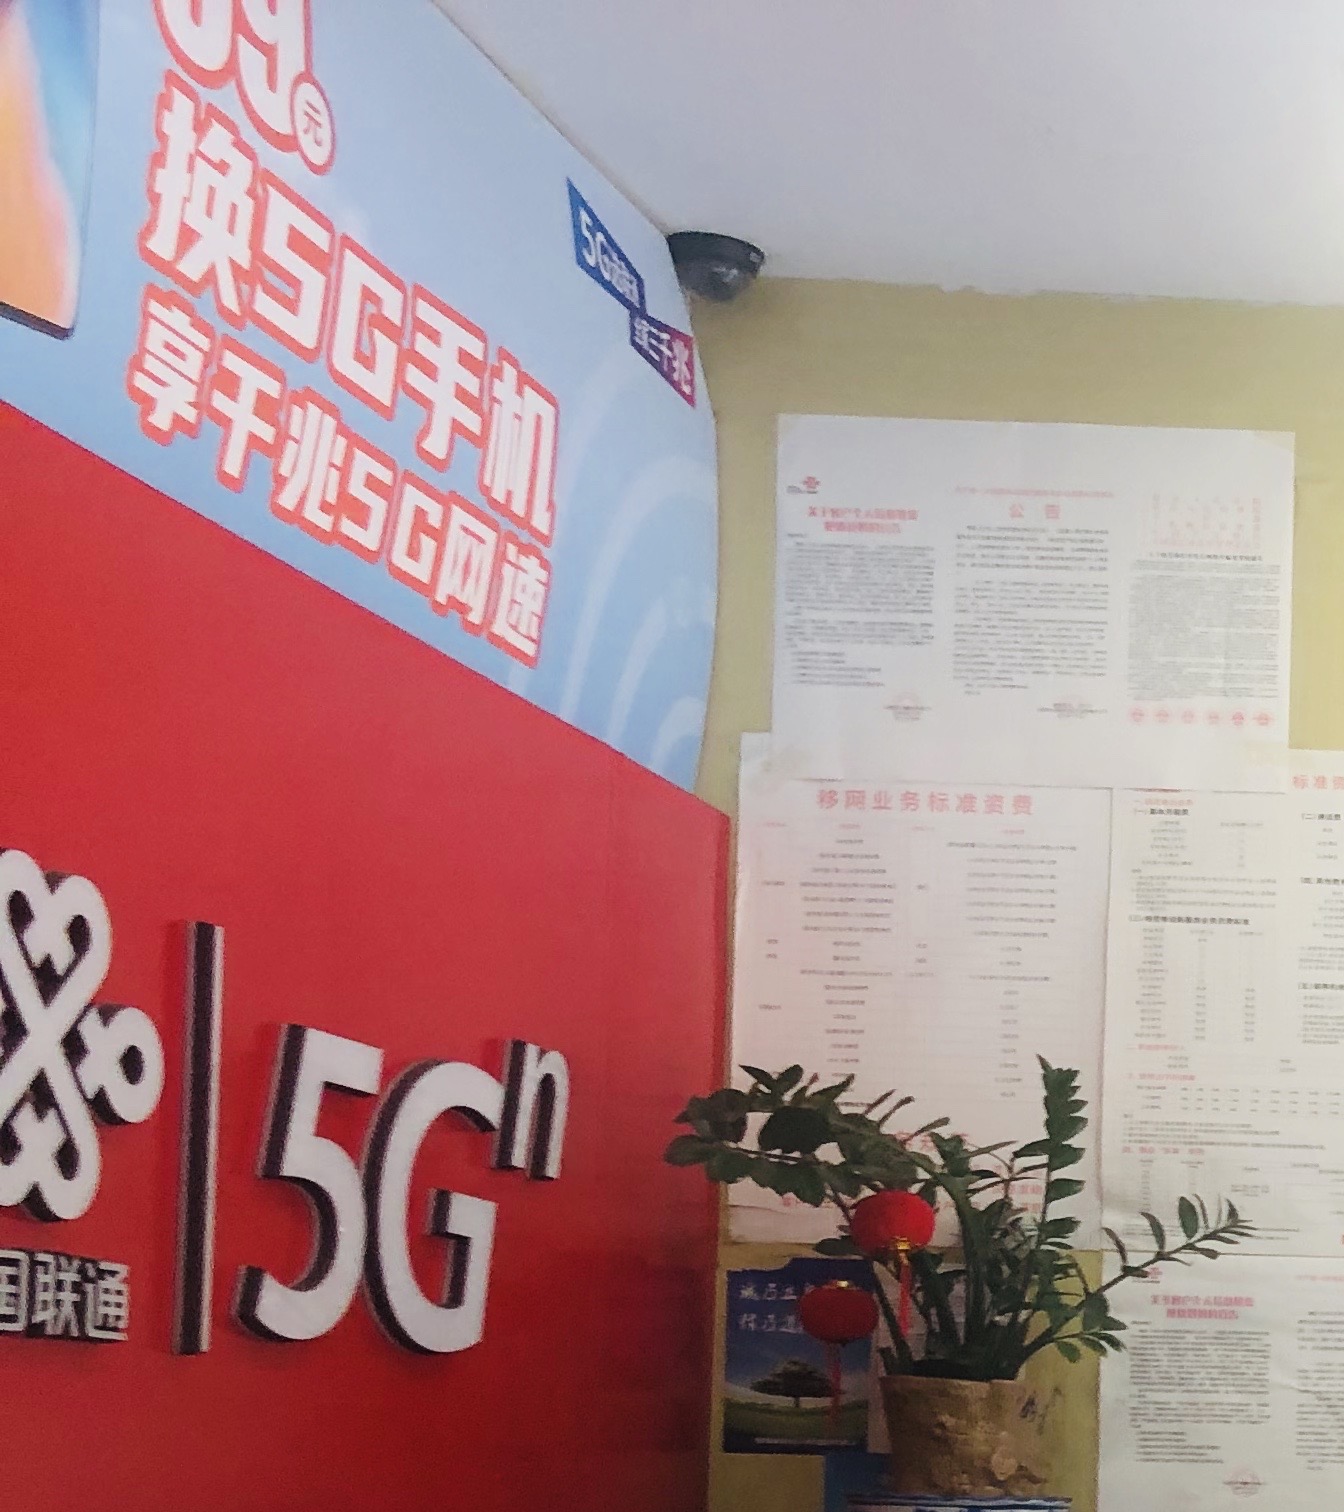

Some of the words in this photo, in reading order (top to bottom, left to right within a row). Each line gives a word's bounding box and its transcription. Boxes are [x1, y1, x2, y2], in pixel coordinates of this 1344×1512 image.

[127, 284, 552, 668] 享千兆5G网速
[140, 70, 560, 546] 换5G手机
